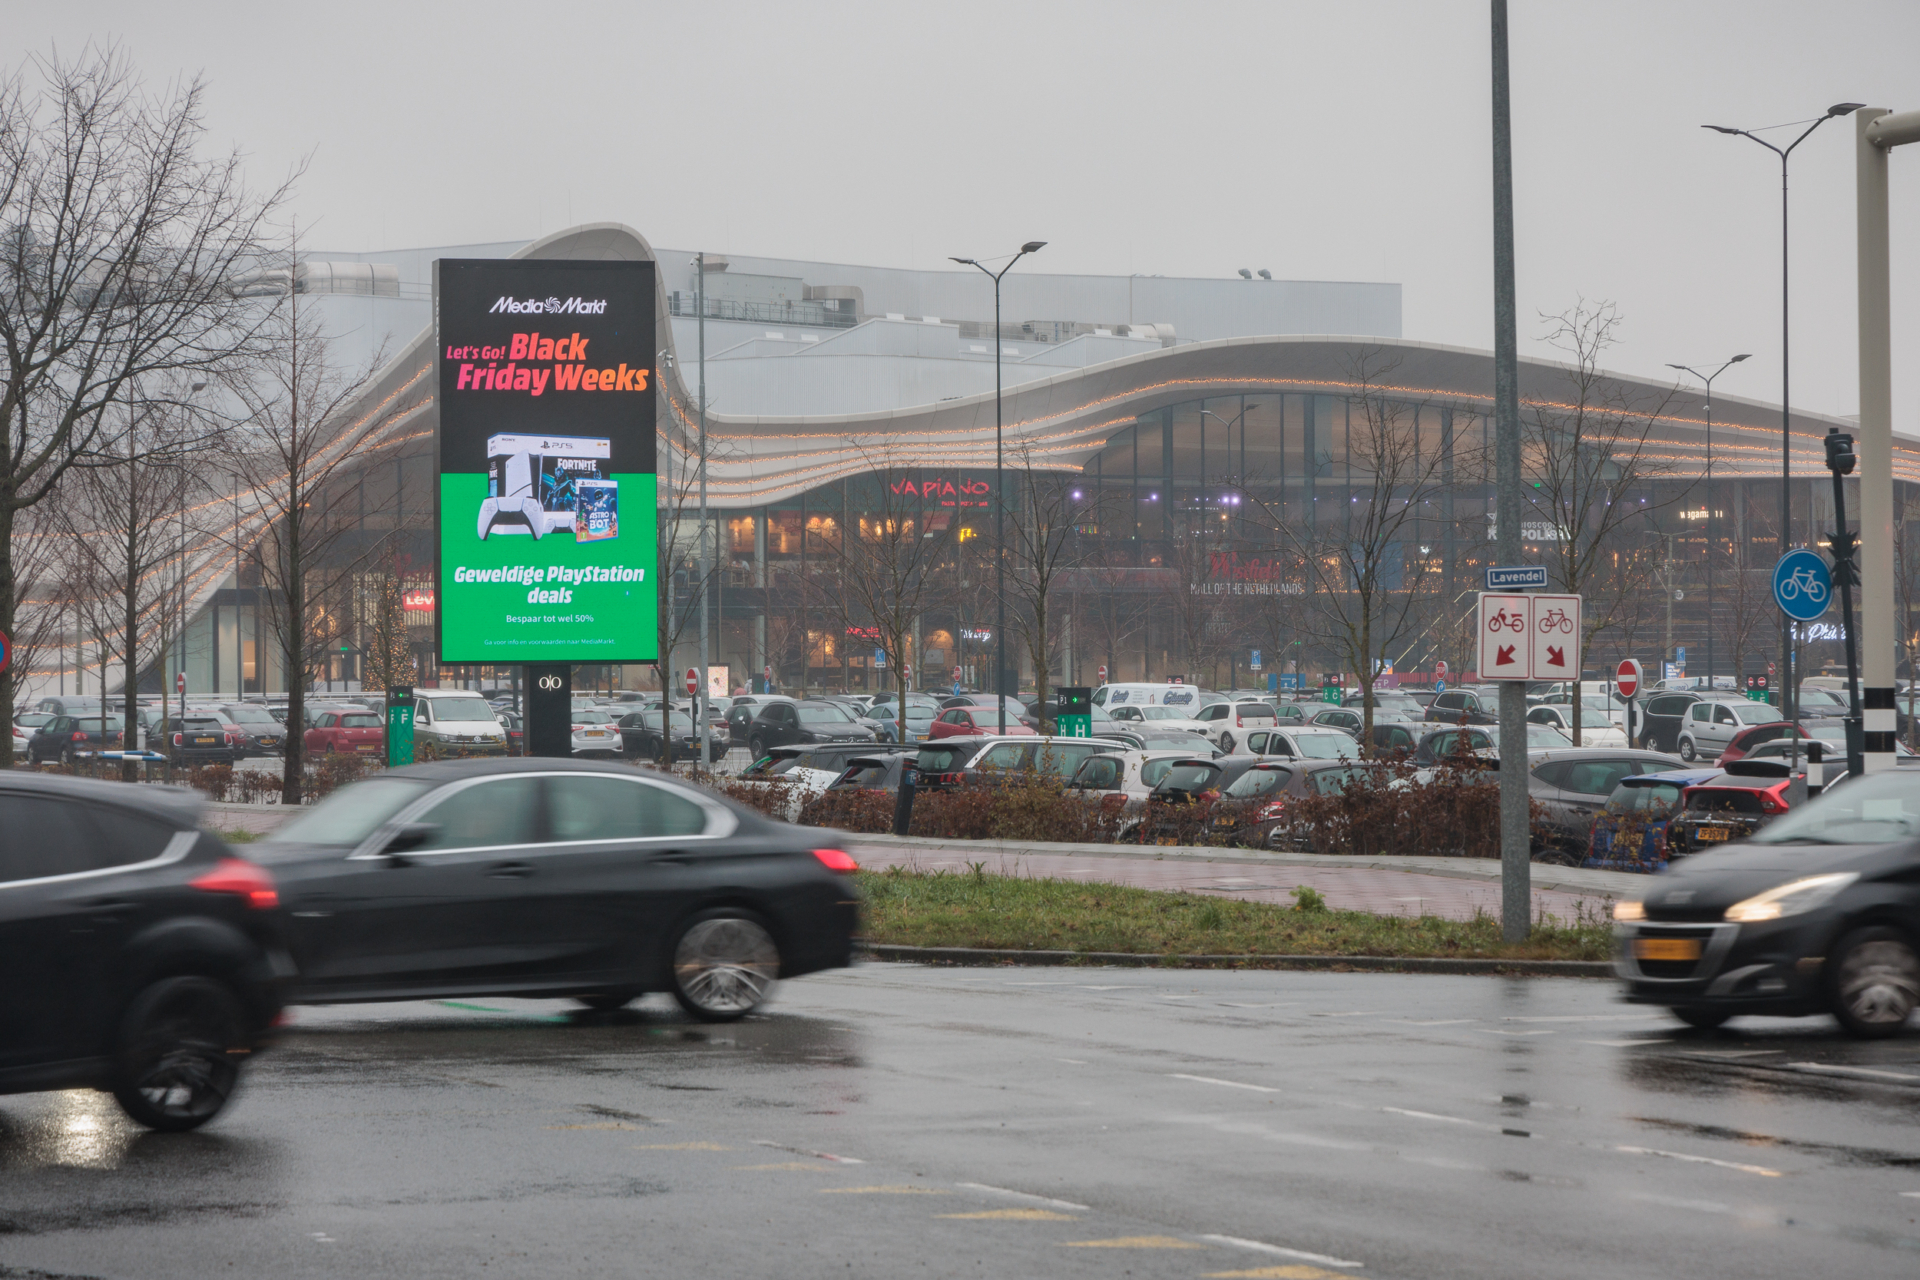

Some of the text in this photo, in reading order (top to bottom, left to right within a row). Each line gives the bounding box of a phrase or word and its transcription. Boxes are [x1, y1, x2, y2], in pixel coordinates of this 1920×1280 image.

[489, 296, 608, 314] Media Markt
[446, 332, 590, 360] Let's Go! Black
[456, 362, 650, 396] Friday Weeks
[557, 458, 597, 472] FORTNITE
[589, 512, 610, 520] ASTRO
[589, 519, 610, 530] BOT
[1487, 528, 1558, 540] KPOLIS
[454, 566, 544, 586] Geweldige
[546, 566, 644, 586] PlayStation
[1492, 571, 1542, 582] Lavendel
[406, 595, 435, 605] Lev
[527, 587, 573, 604] deals
[506, 614, 542, 624] Bespaar
[557, 614, 574, 622] wel
[575, 614, 594, 622] 50%
[401, 714, 408, 724] F
[1076, 724, 1086, 738] H
